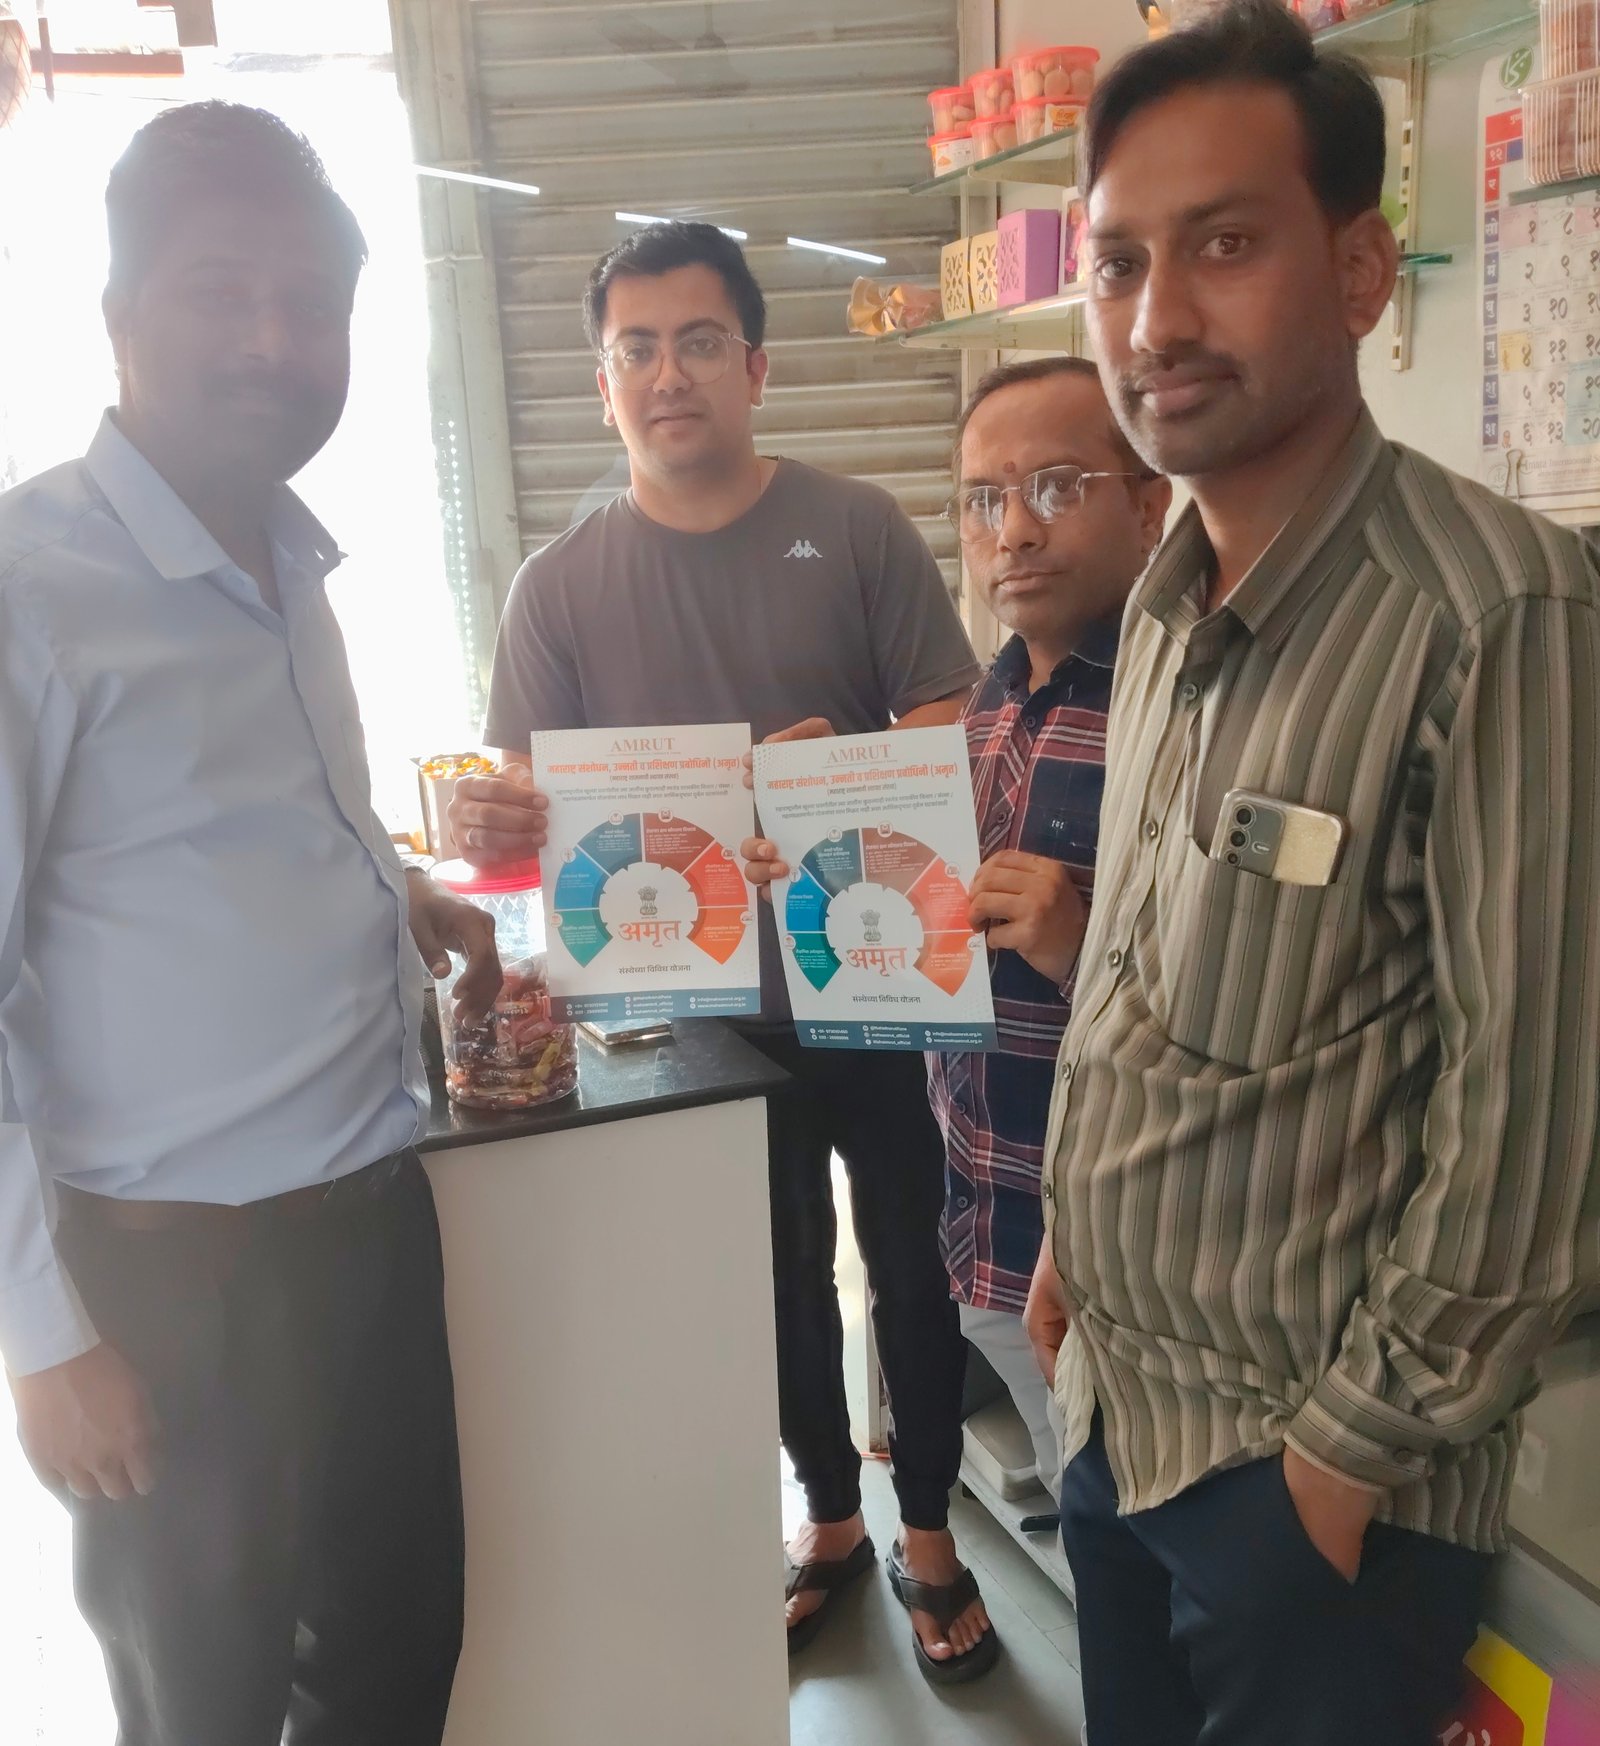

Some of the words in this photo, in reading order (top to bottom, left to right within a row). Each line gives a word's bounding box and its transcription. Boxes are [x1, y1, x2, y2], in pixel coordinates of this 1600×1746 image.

[1528, 220, 1537, 243] १
[1525, 262, 1535, 284] २
[1561, 255, 1570, 277] ९
[1523, 303, 1533, 325] ३
[1549, 297, 1568, 320] १०
[1522, 344, 1531, 367] ४
[1549, 338, 1567, 363] ११
[1548, 381, 1565, 403] १२
[1523, 423, 1532, 446] ६
[1548, 421, 1564, 443] १३
[610, 738, 676, 752] AMRUT
[827, 744, 890, 763] AMRUT
[618, 920, 682, 947] अमृत
[649, 963, 668, 973] विविध
[670, 963, 691, 973] योजना
[846, 947, 907, 977] अमृत
[852, 994, 878, 1003] संस्थेच्या
[879, 994, 899, 1003] विविध
[900, 995, 921, 1004] योजना
